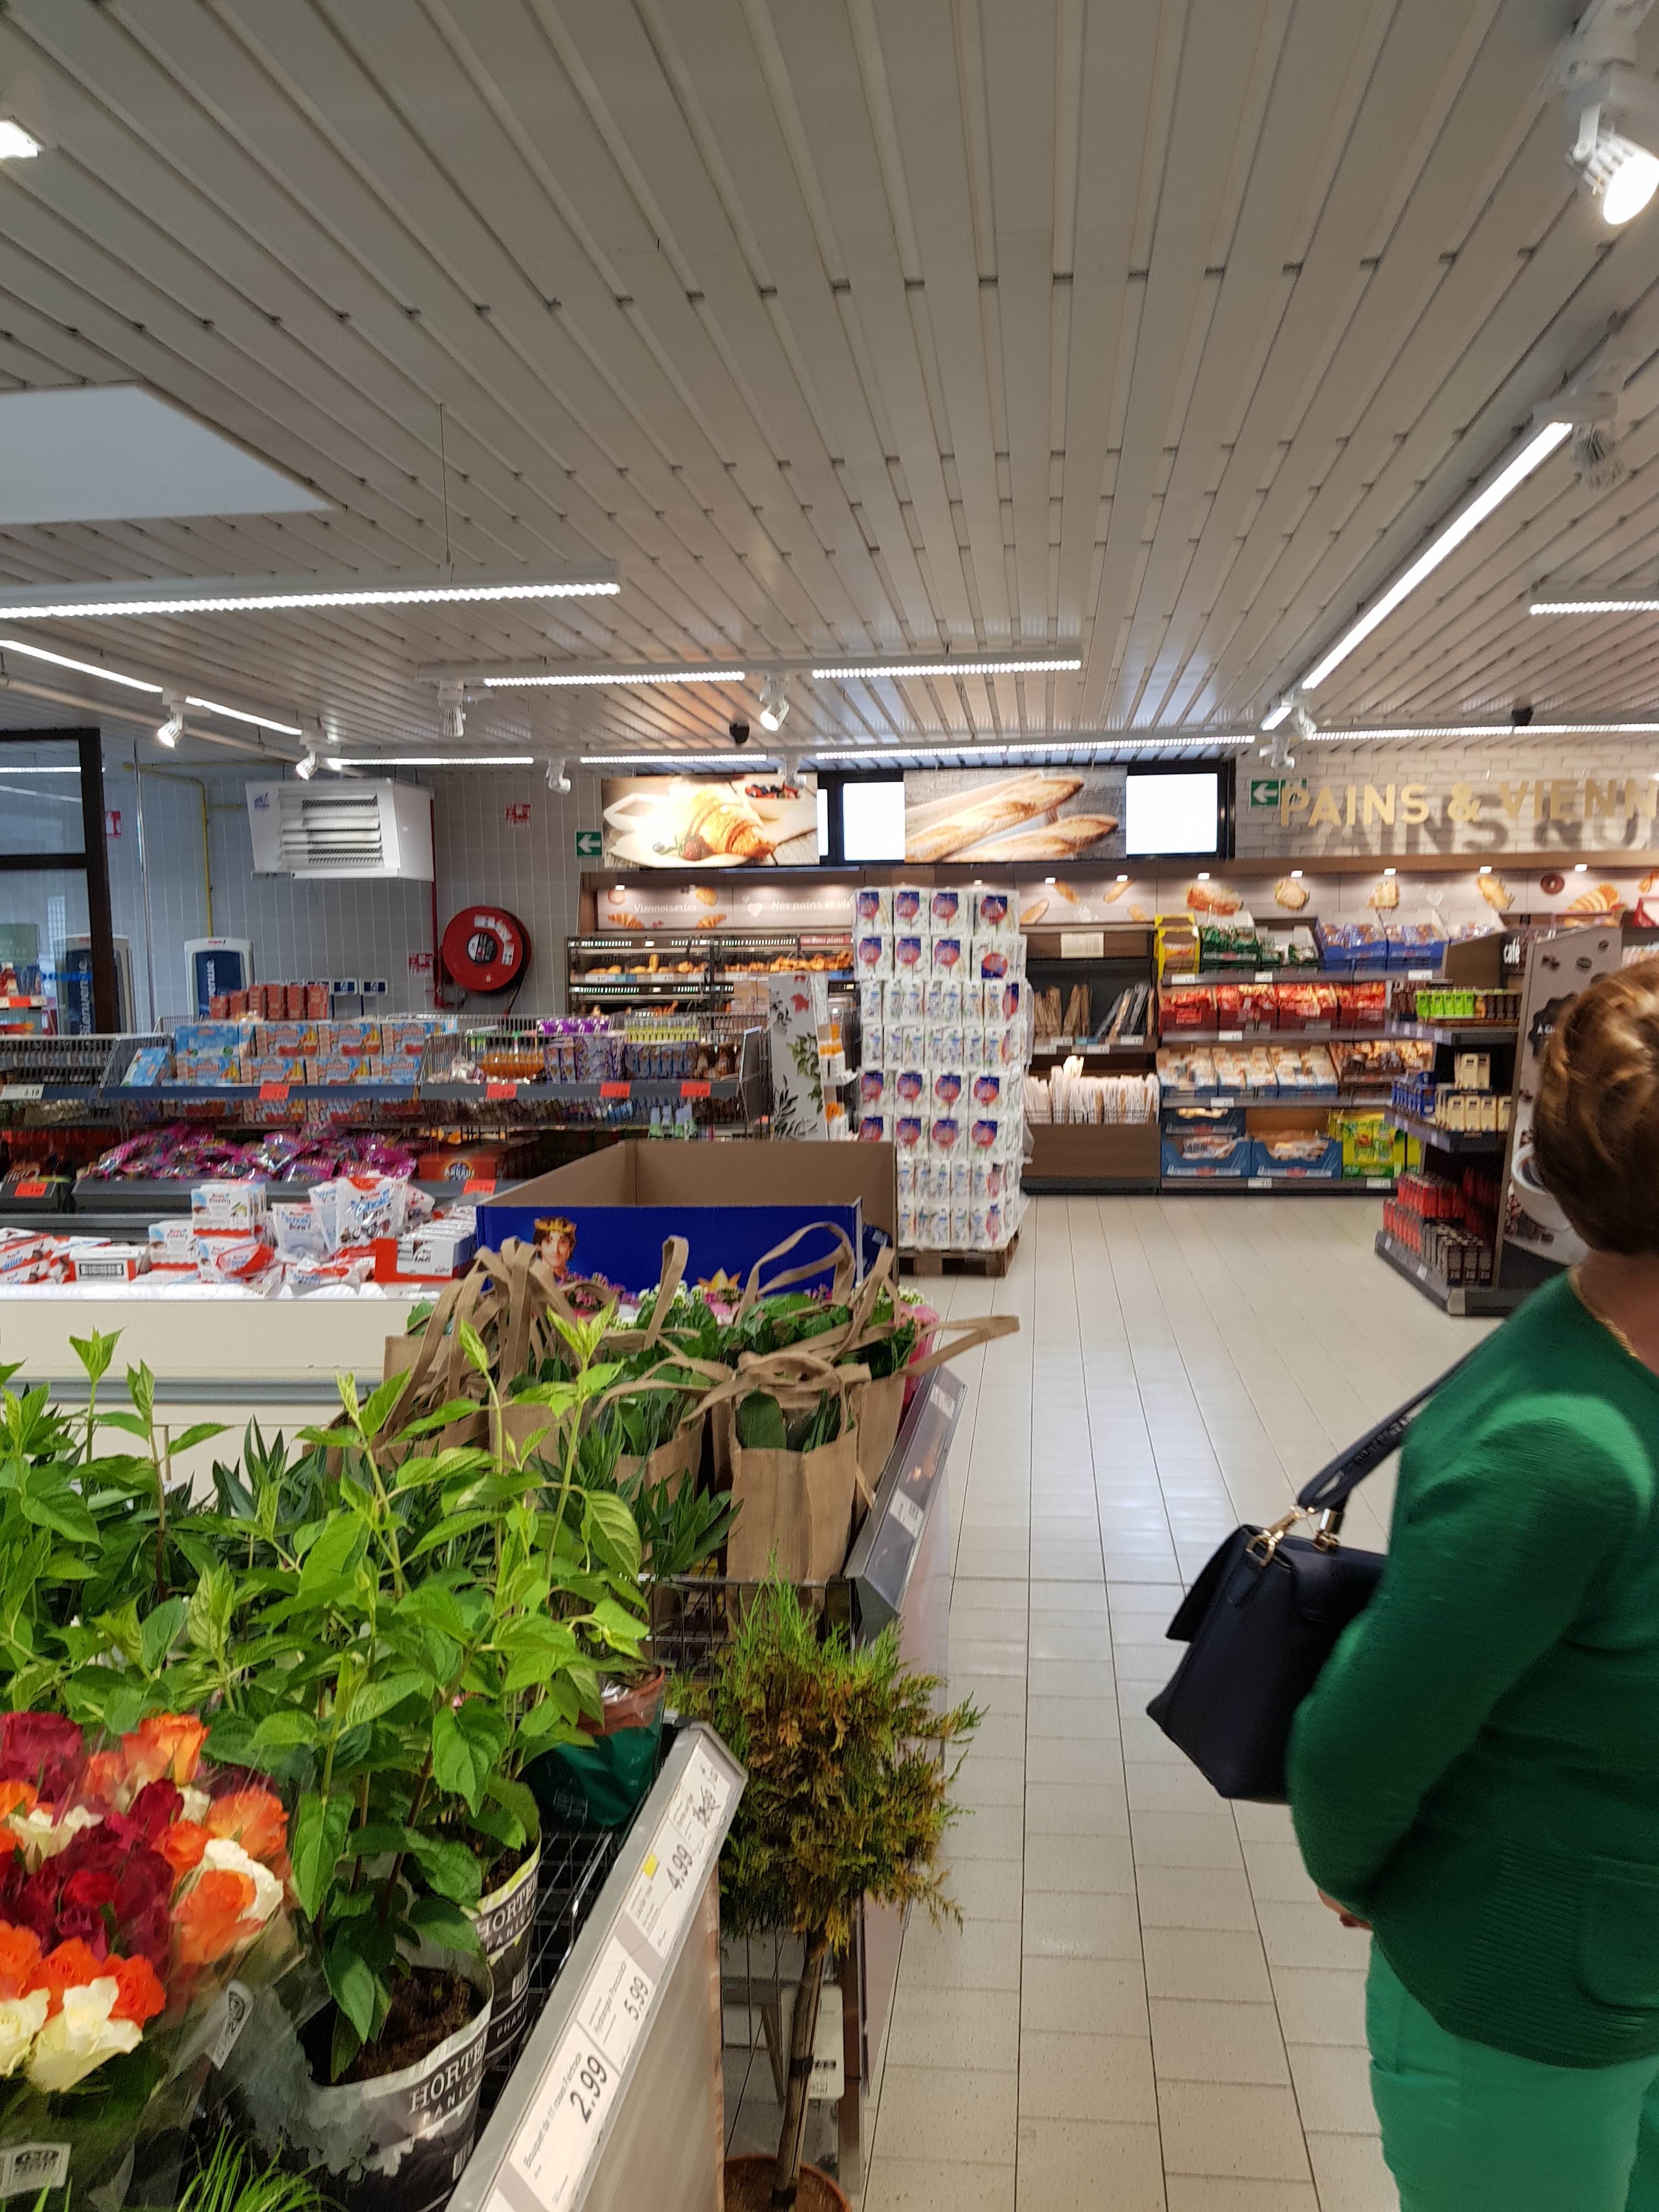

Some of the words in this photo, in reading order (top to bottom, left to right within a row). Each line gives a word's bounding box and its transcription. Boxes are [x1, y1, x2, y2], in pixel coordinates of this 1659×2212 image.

[1280, 783, 1429, 826] PAINS
[1447, 783, 1482, 822] &
[772, 900, 790, 910] Nos
[792, 900, 822, 912] pains
[667, 1843, 692, 1889] 4.99
[624, 1976, 648, 2021] 5.99
[570, 2056, 607, 2124] 2.99
